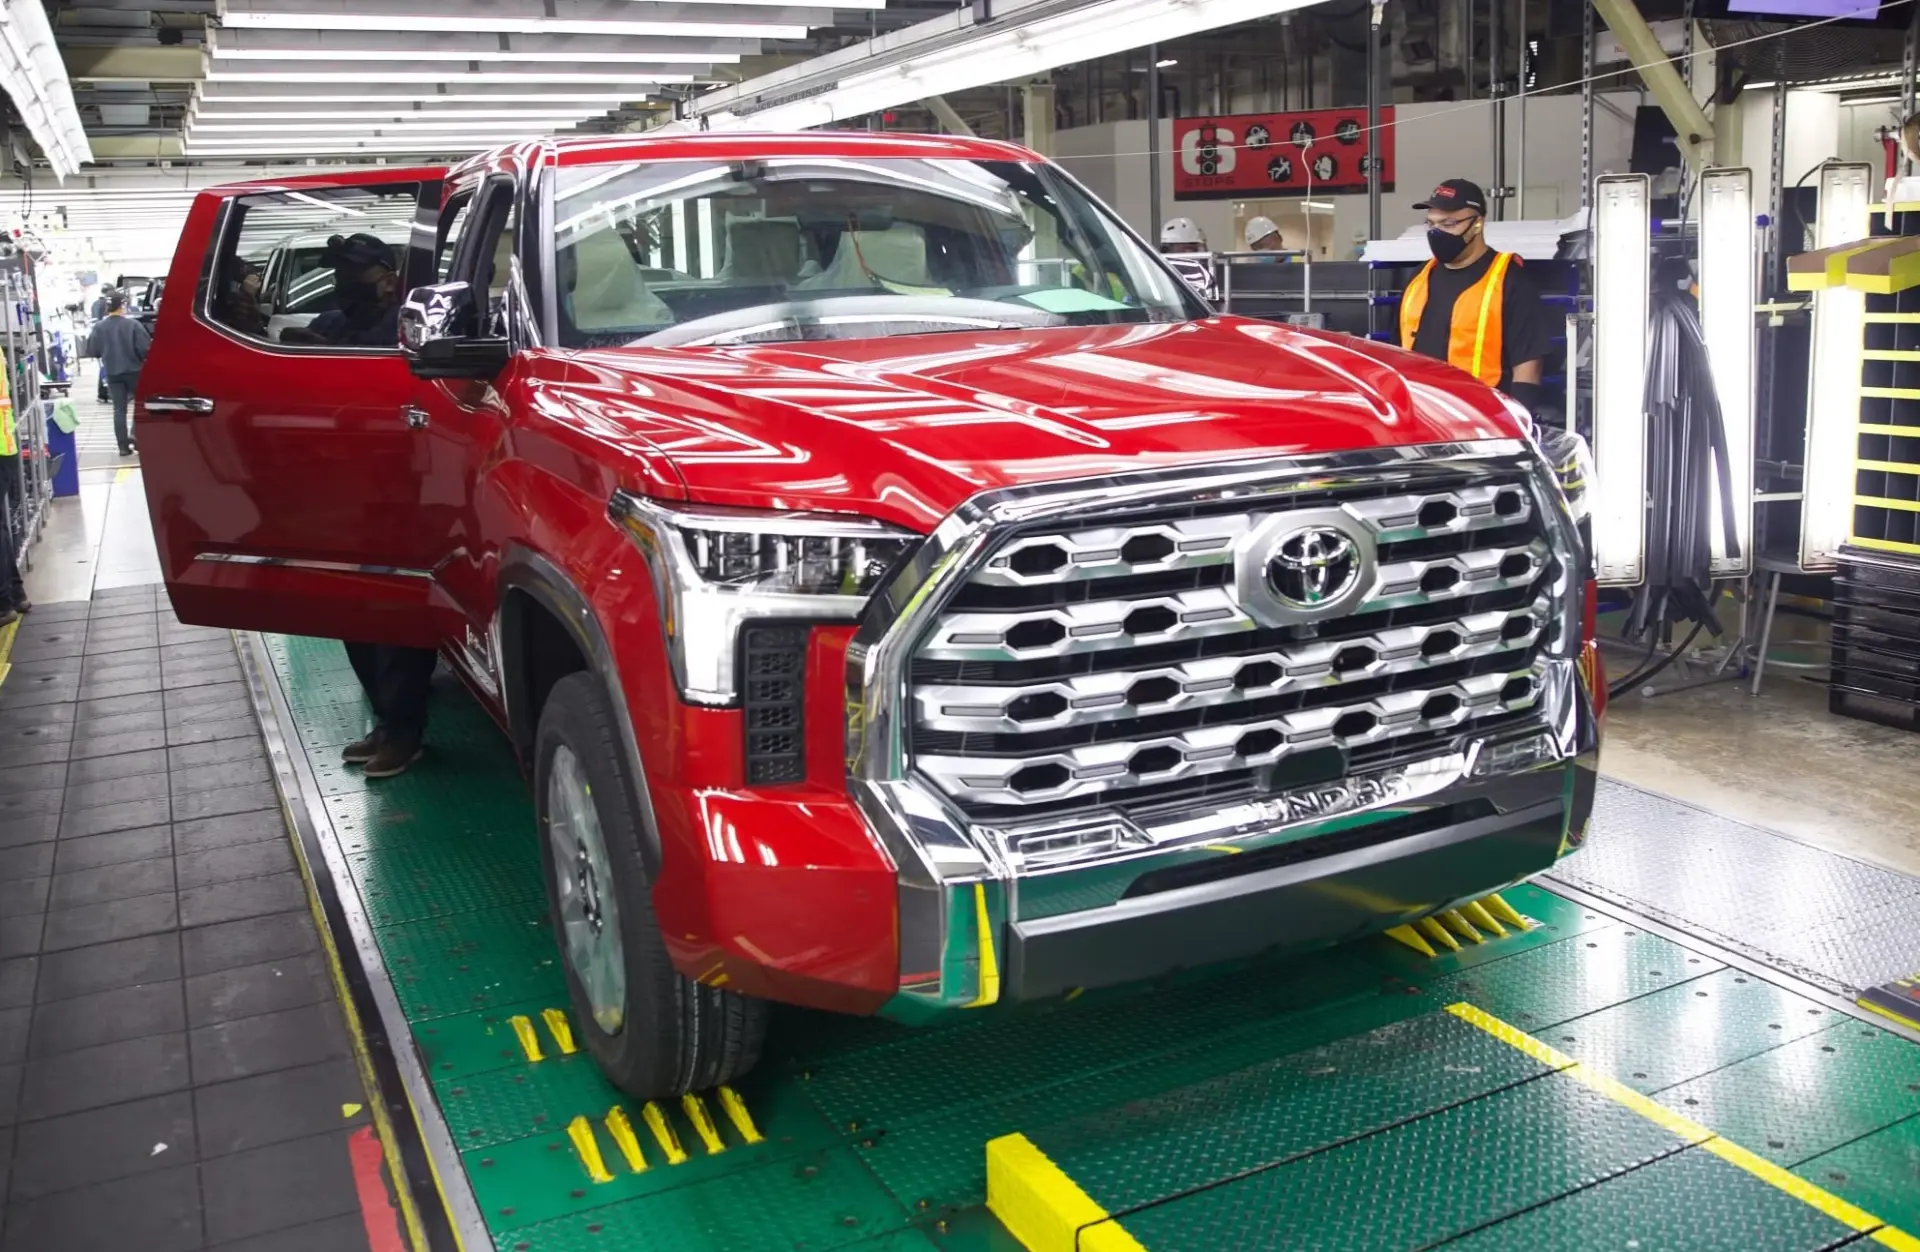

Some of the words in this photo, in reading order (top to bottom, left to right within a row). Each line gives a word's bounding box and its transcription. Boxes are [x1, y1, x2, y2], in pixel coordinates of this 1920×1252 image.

[1181, 127, 1237, 176] 6
[1183, 175, 1236, 188] STOPS
[1240, 772, 1413, 831] UNDRA
